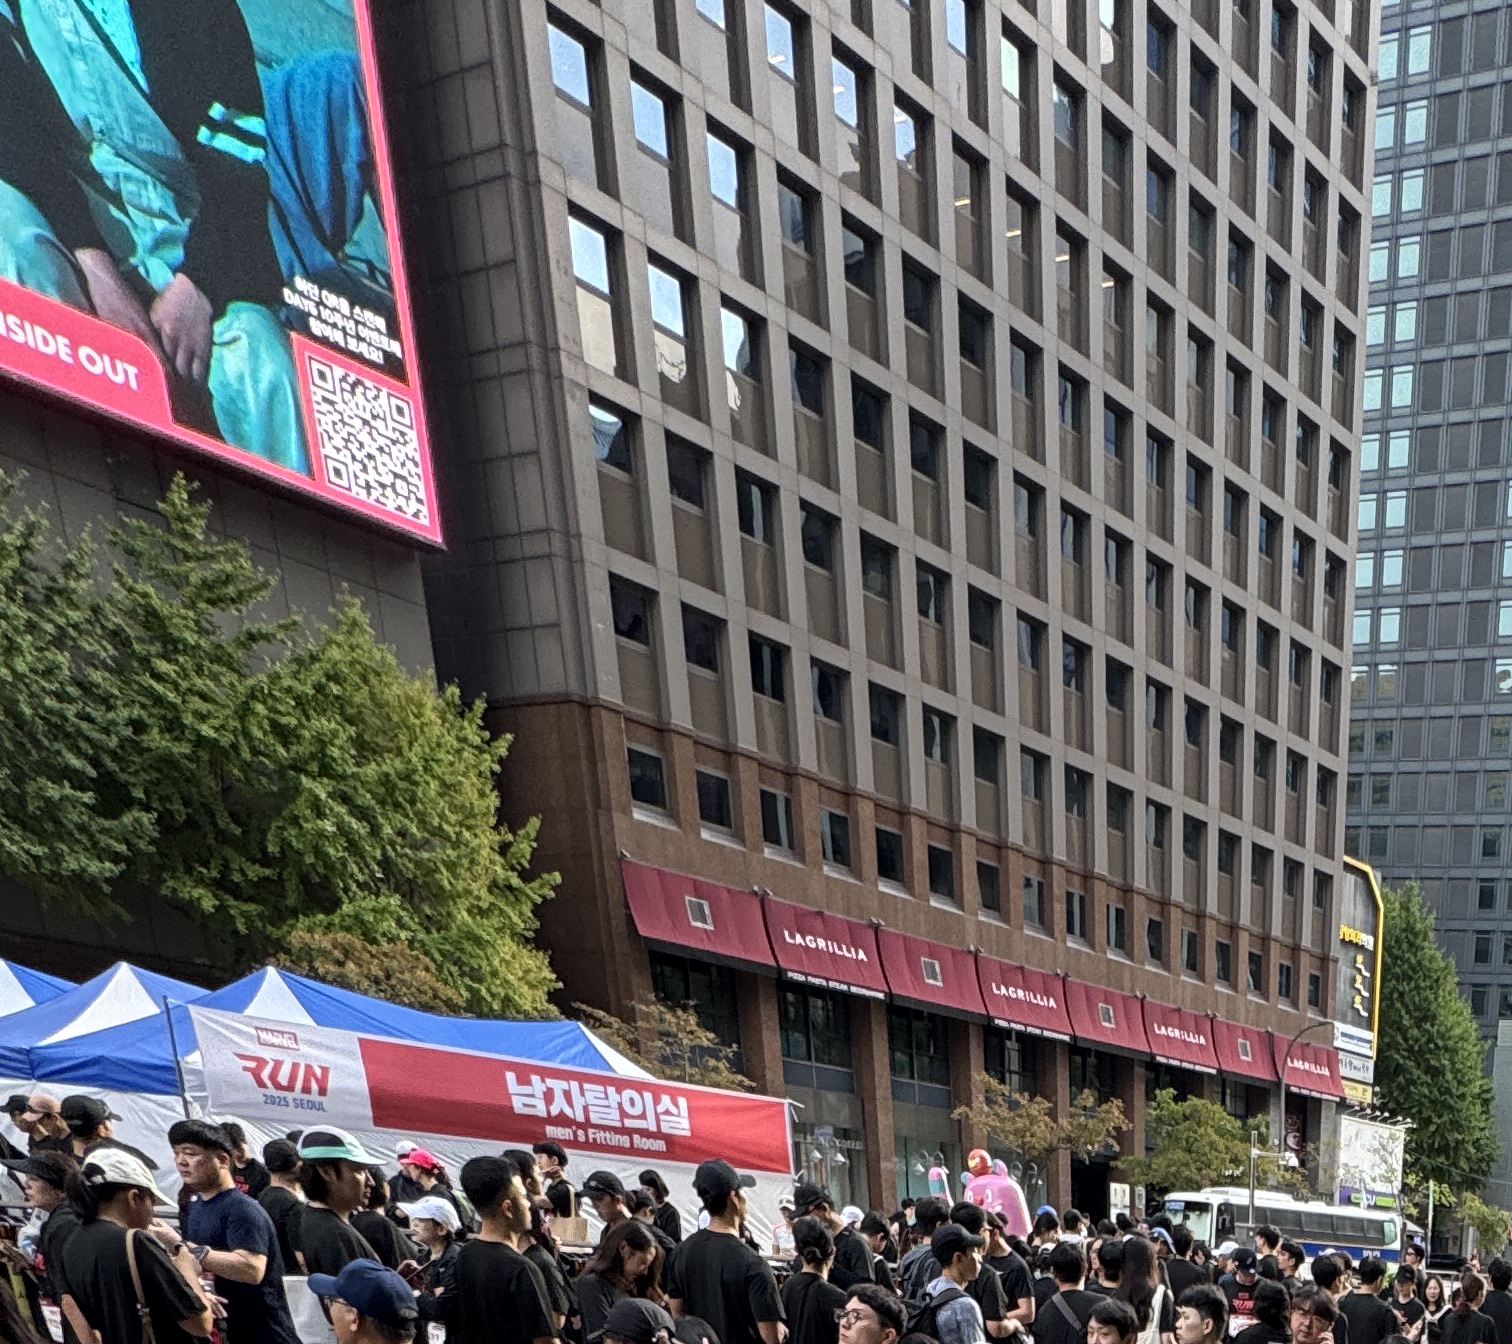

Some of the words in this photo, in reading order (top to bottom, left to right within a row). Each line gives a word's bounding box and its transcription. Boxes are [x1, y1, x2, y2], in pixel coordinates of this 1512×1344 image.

[78, 345, 139, 391] OUT
[783, 928, 869, 962] LAGRILLIA
[991, 981, 1058, 1009] LAGRILLIA
[1153, 1022, 1207, 1046] LAGRILLIA
[232, 1052, 331, 1097] RUN
[1287, 1056, 1330, 1077] LAGRILLIA
[262, 1093, 290, 1109] 2025
[292, 1097, 328, 1113] SEOUL
[505, 1070, 692, 1137] 남자탈의실
[545, 1124, 586, 1143] men's
[588, 1128, 630, 1148] Fitting
[633, 1133, 667, 1153] Room
